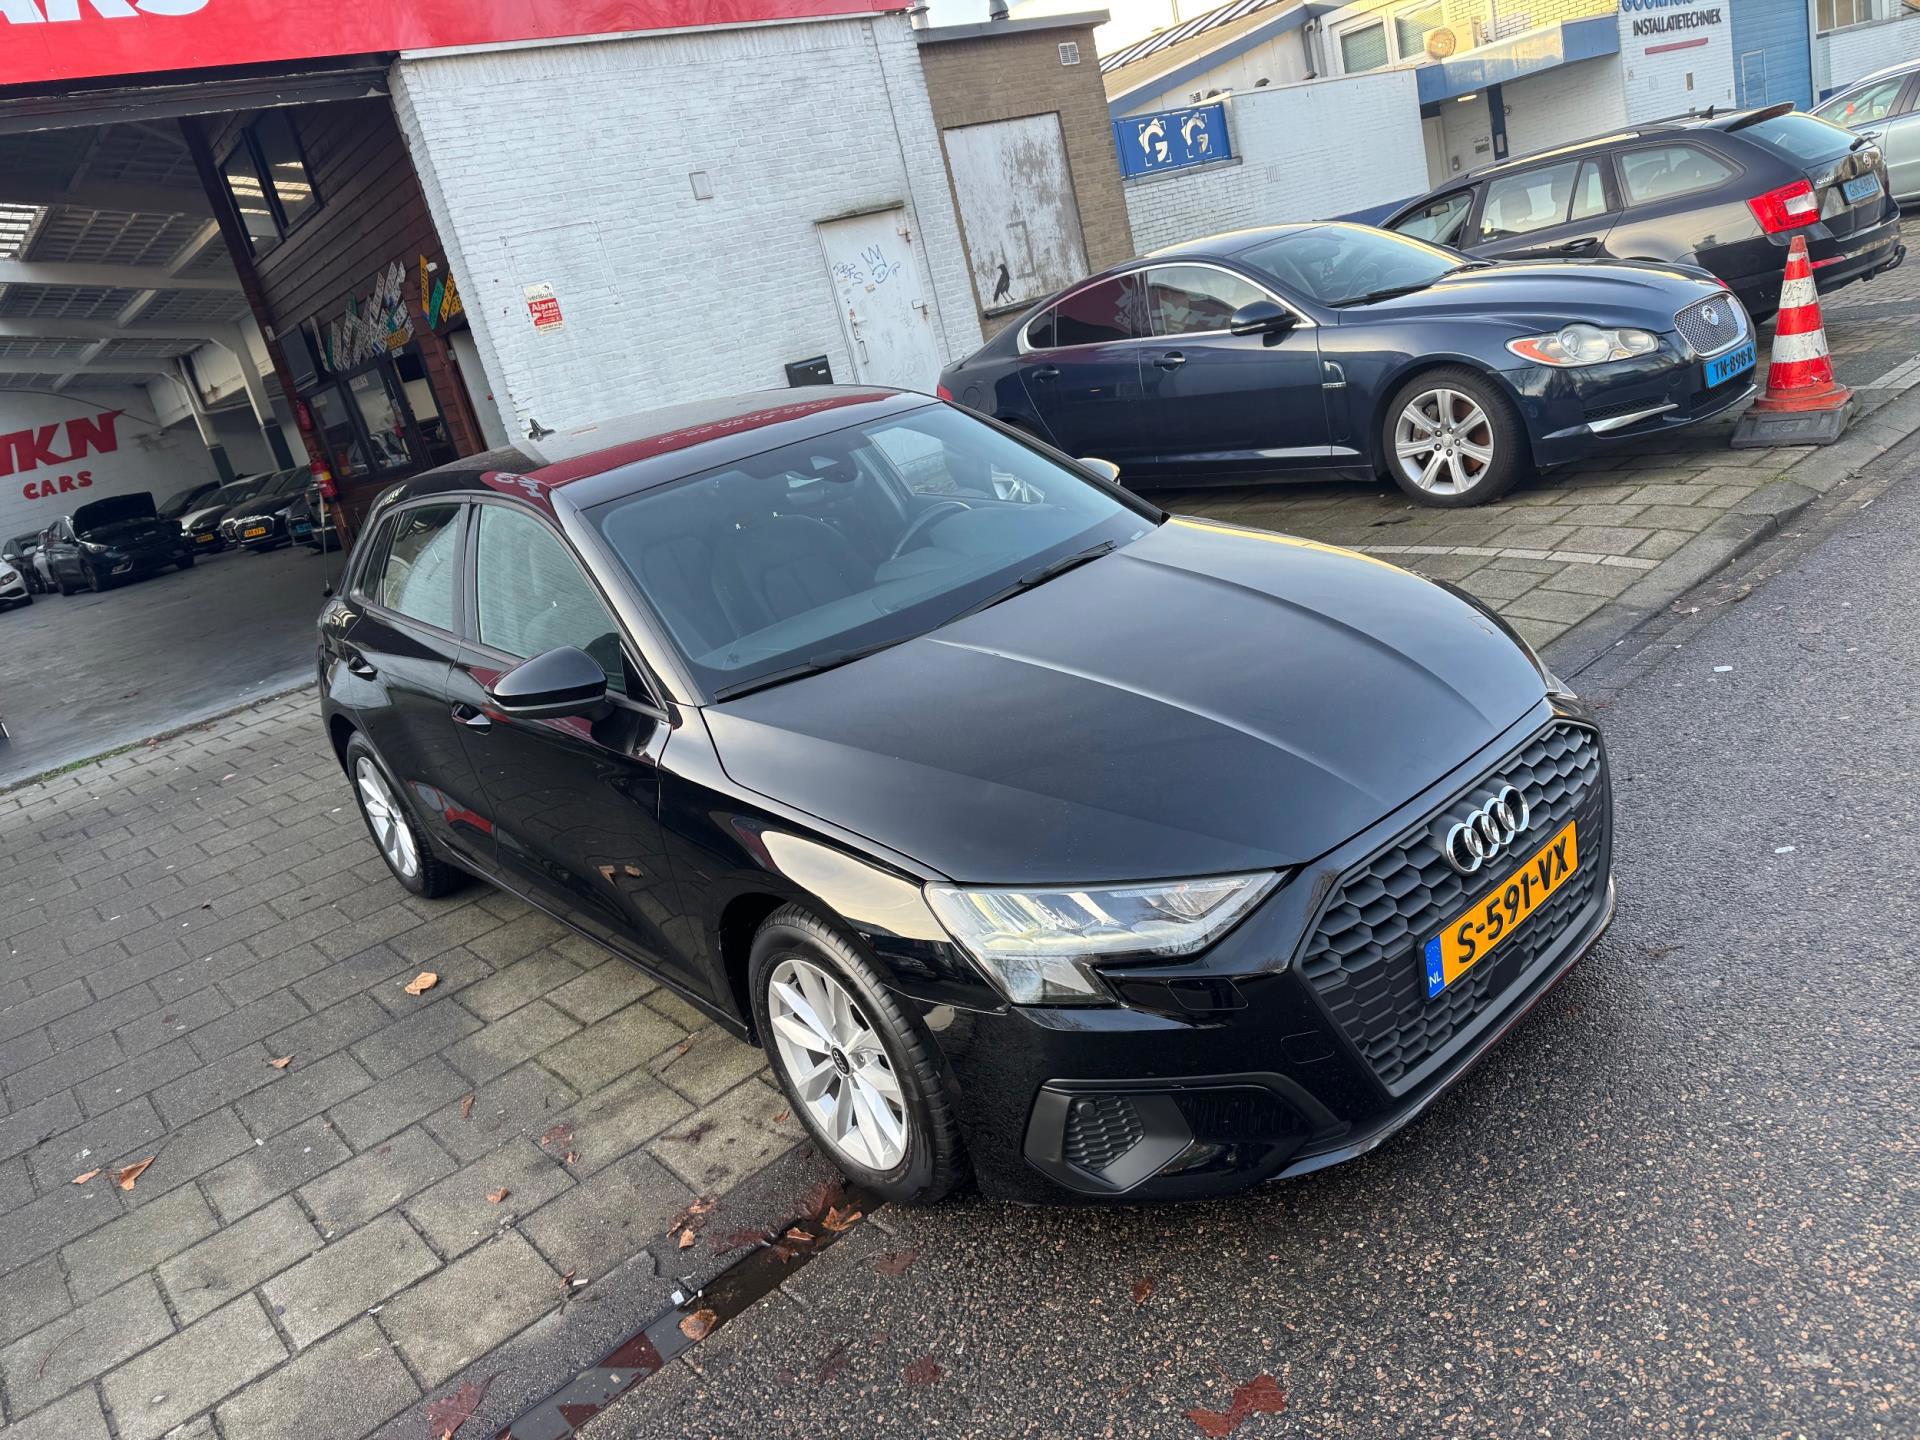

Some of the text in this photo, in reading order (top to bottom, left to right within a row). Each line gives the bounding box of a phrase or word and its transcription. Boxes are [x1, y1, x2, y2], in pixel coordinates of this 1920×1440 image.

[1633, 8, 1722, 36] INSTALLATIETECHNIEK
[531, 301, 558, 312] Alarm
[23, 471, 93, 500] CARS
[1457, 836, 1568, 964] S-591-VX
[1428, 970, 1442, 988] NL
